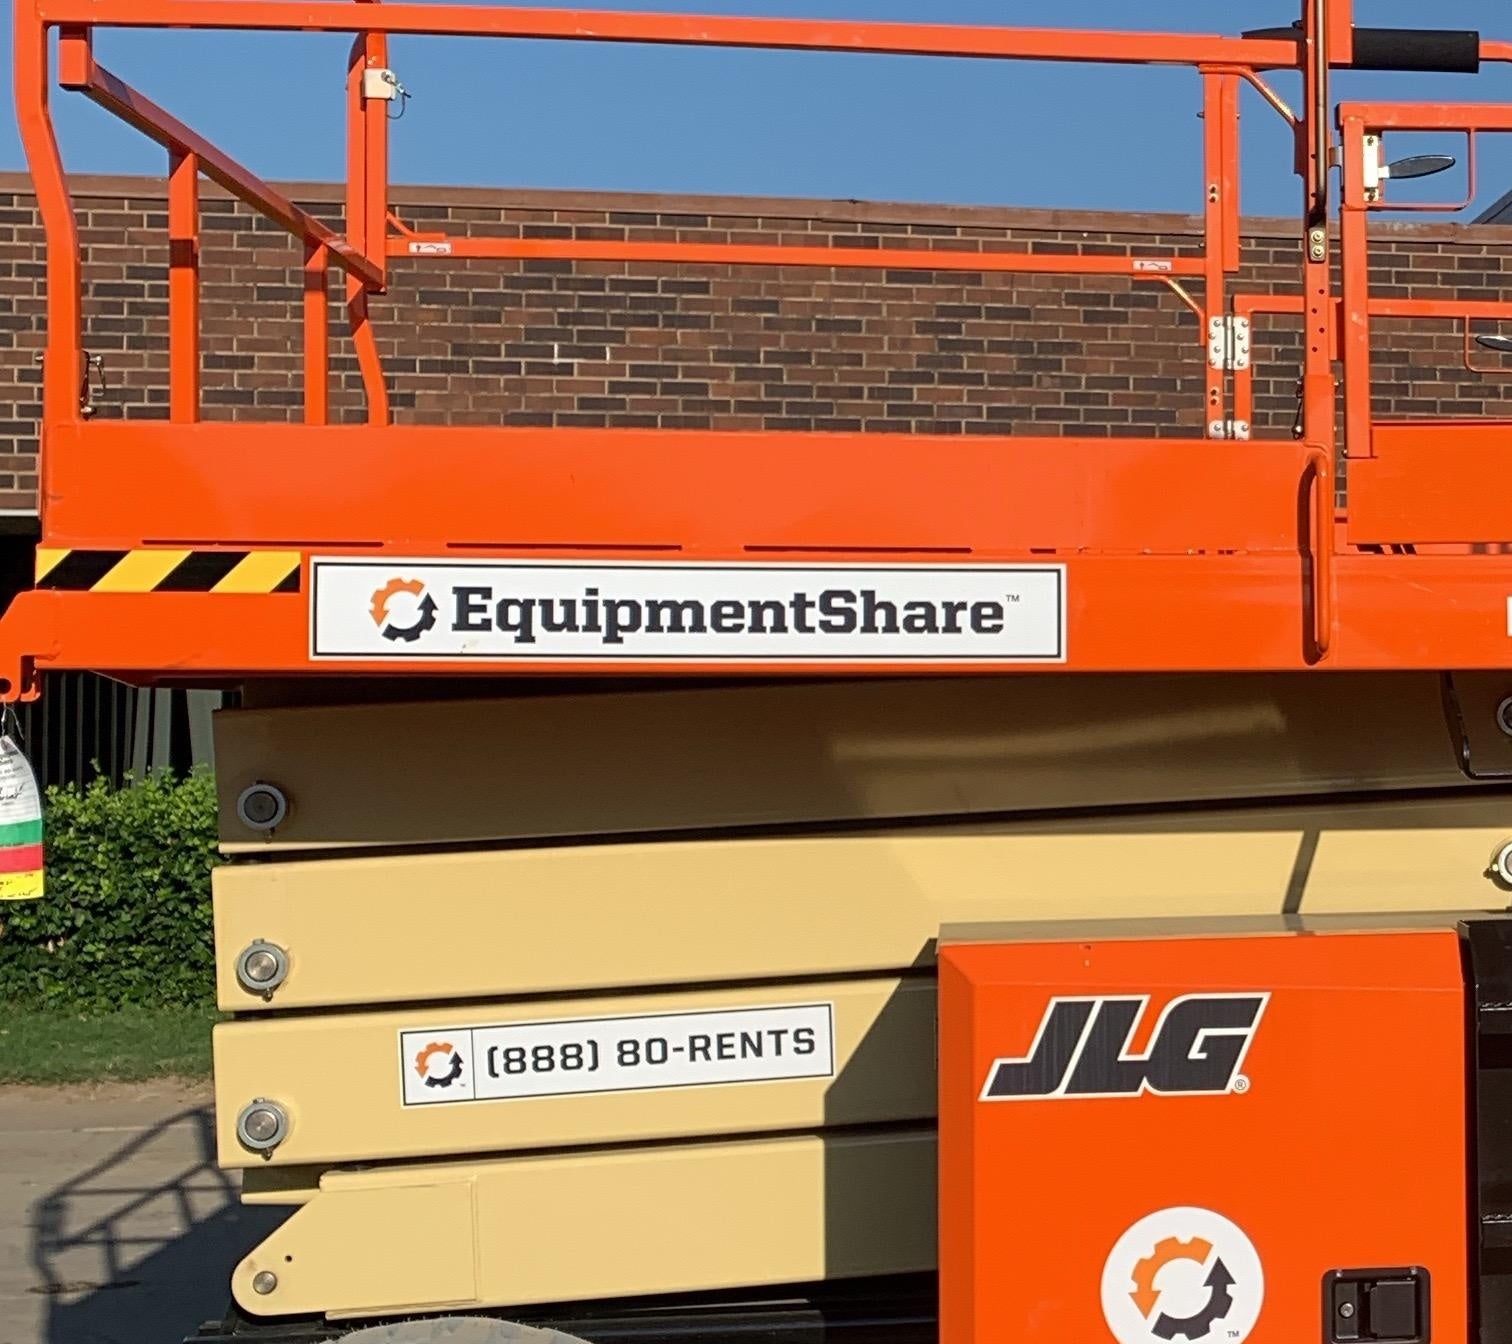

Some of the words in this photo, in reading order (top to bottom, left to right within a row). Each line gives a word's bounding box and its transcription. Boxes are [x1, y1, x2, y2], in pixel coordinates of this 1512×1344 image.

[452, 586, 1005, 644] EquipmentShare
[487, 1039, 599, 1078] (888)
[616, 1026, 817, 1068] 80-RENTS
[979, 992, 1271, 1101] JLG
